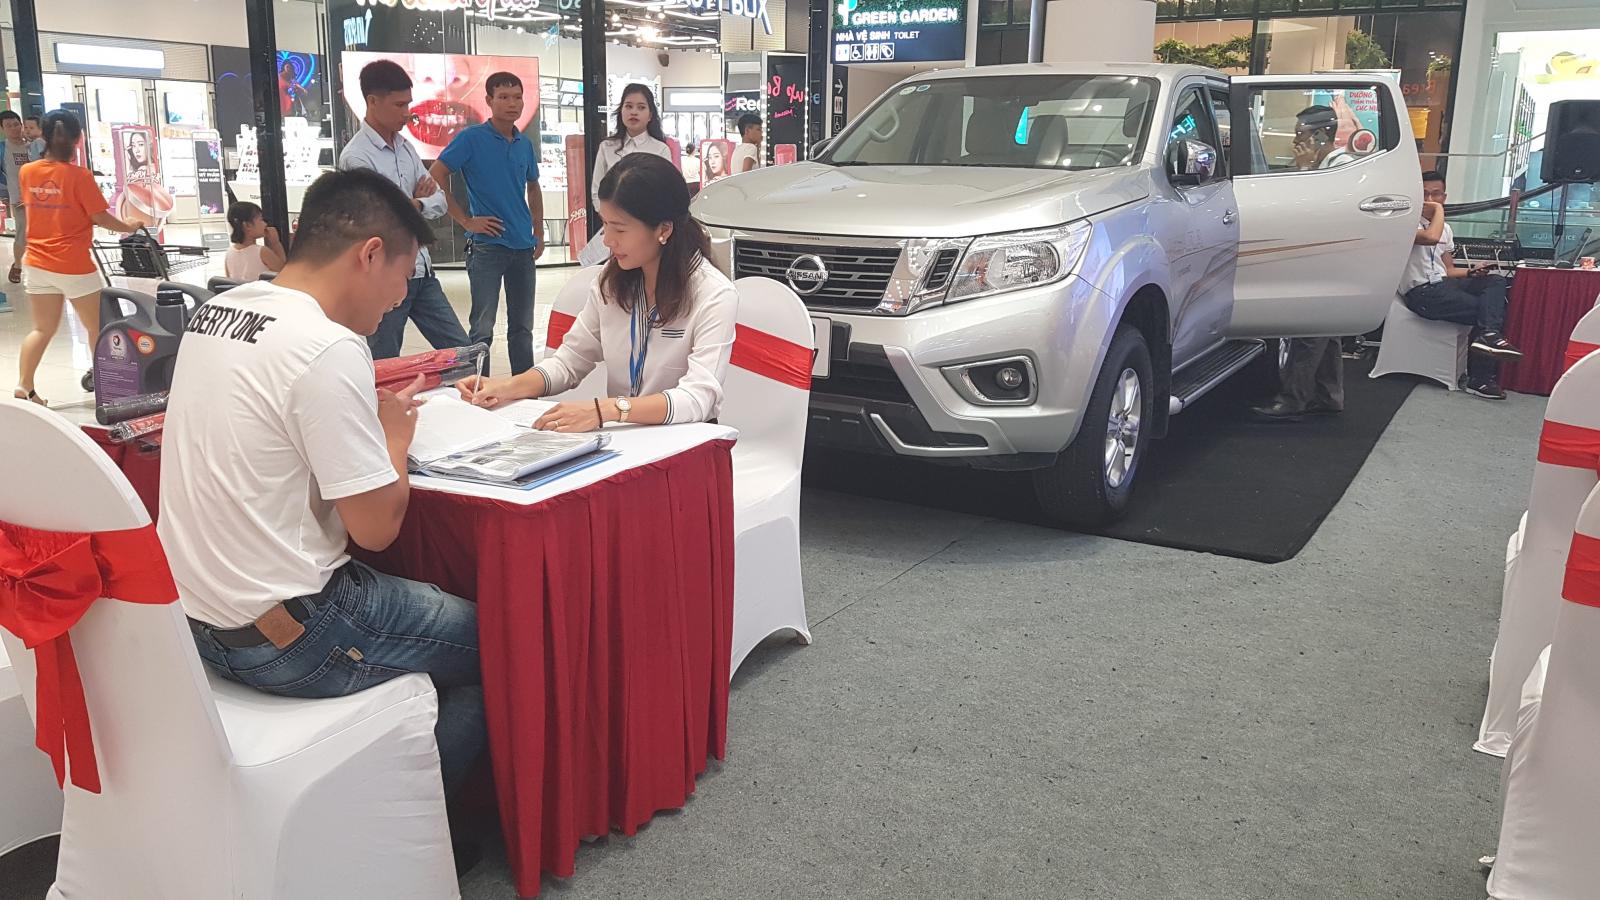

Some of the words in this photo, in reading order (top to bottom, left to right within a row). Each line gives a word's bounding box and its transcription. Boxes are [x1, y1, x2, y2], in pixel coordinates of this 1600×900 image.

[851, 10, 897, 25] GREEN
[899, 8, 958, 23] GARDEN
[836, 30, 854, 42] NHÀ
[869, 31, 890, 40] SINH
[894, 31, 920, 40] TOILET
[790, 271, 823, 281] NISSAN
[230, 311, 277, 344] ONE
